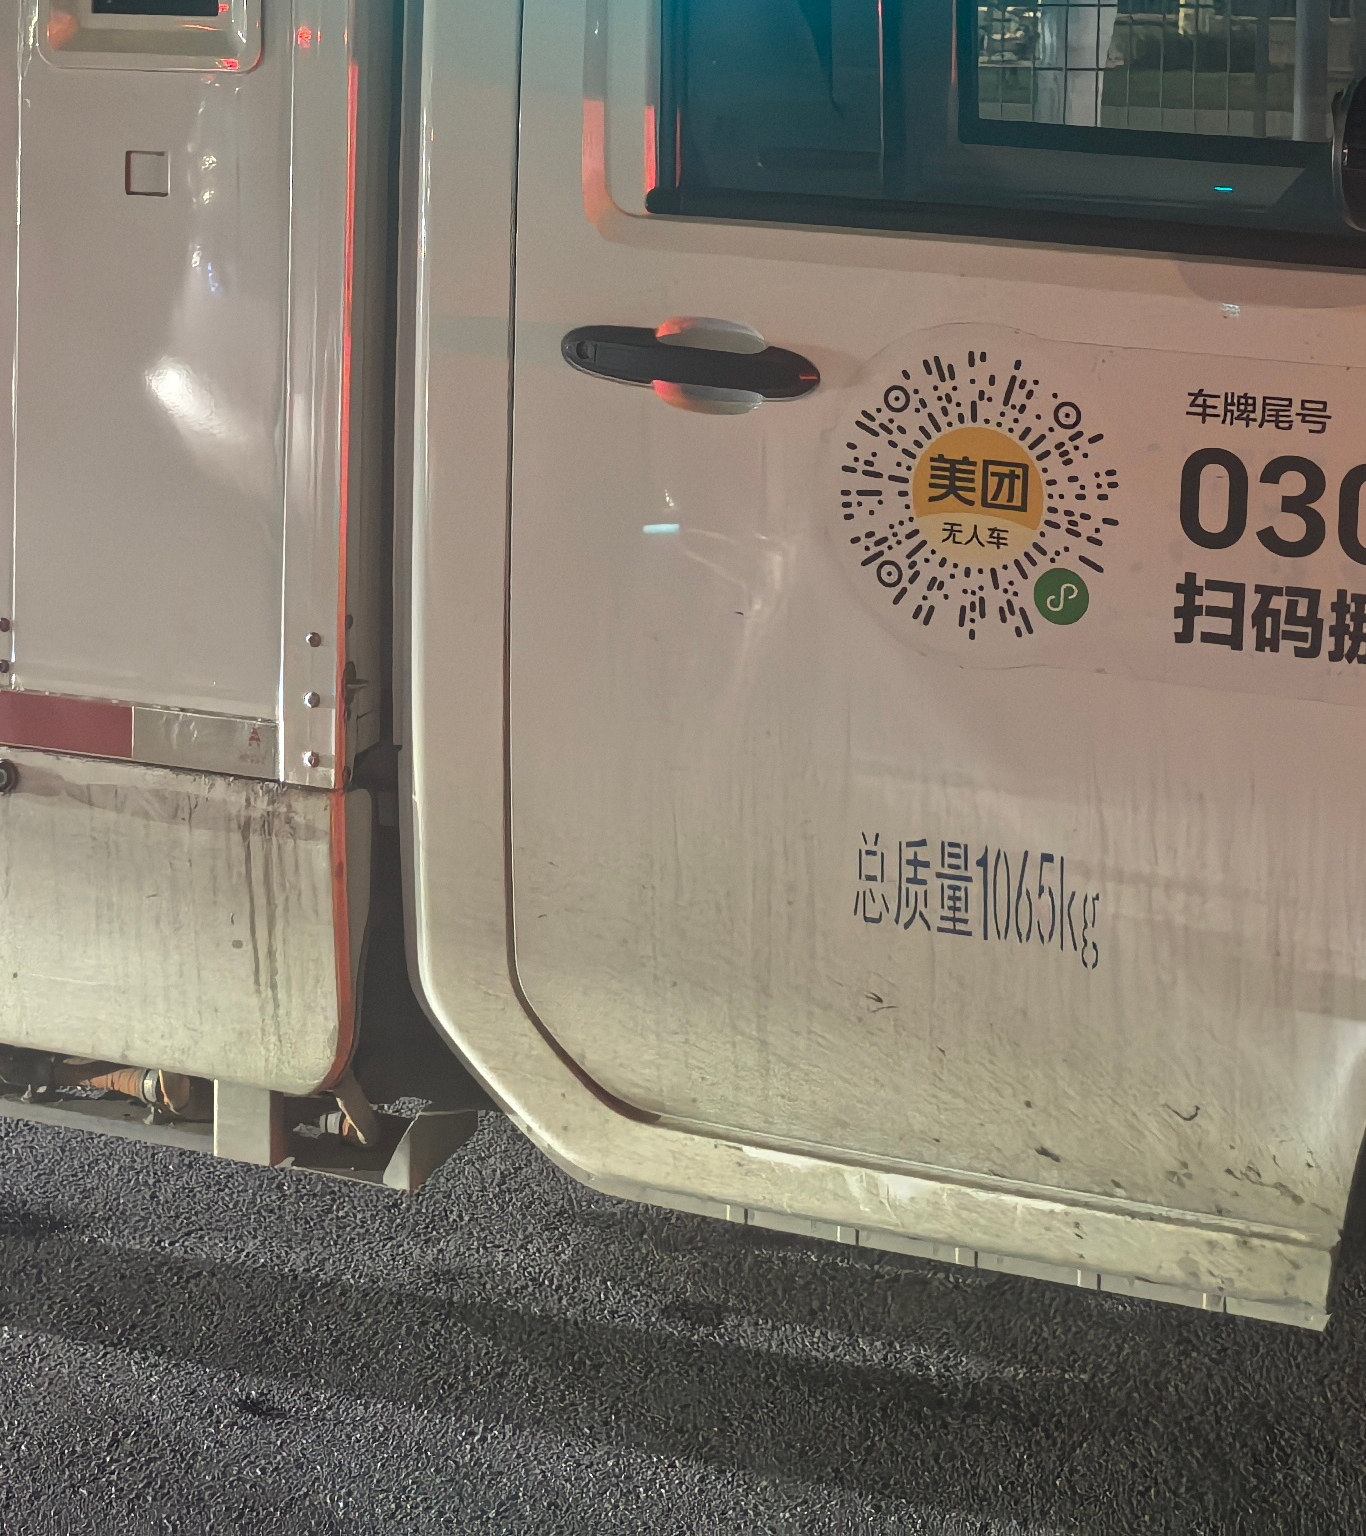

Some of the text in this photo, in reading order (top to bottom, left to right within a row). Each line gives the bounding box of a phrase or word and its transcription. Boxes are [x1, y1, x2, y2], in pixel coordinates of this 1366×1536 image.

[1185, 388, 1332, 434] 车牌尾号
[928, 453, 1029, 512] 美团
[941, 522, 1009, 549] 无人车
